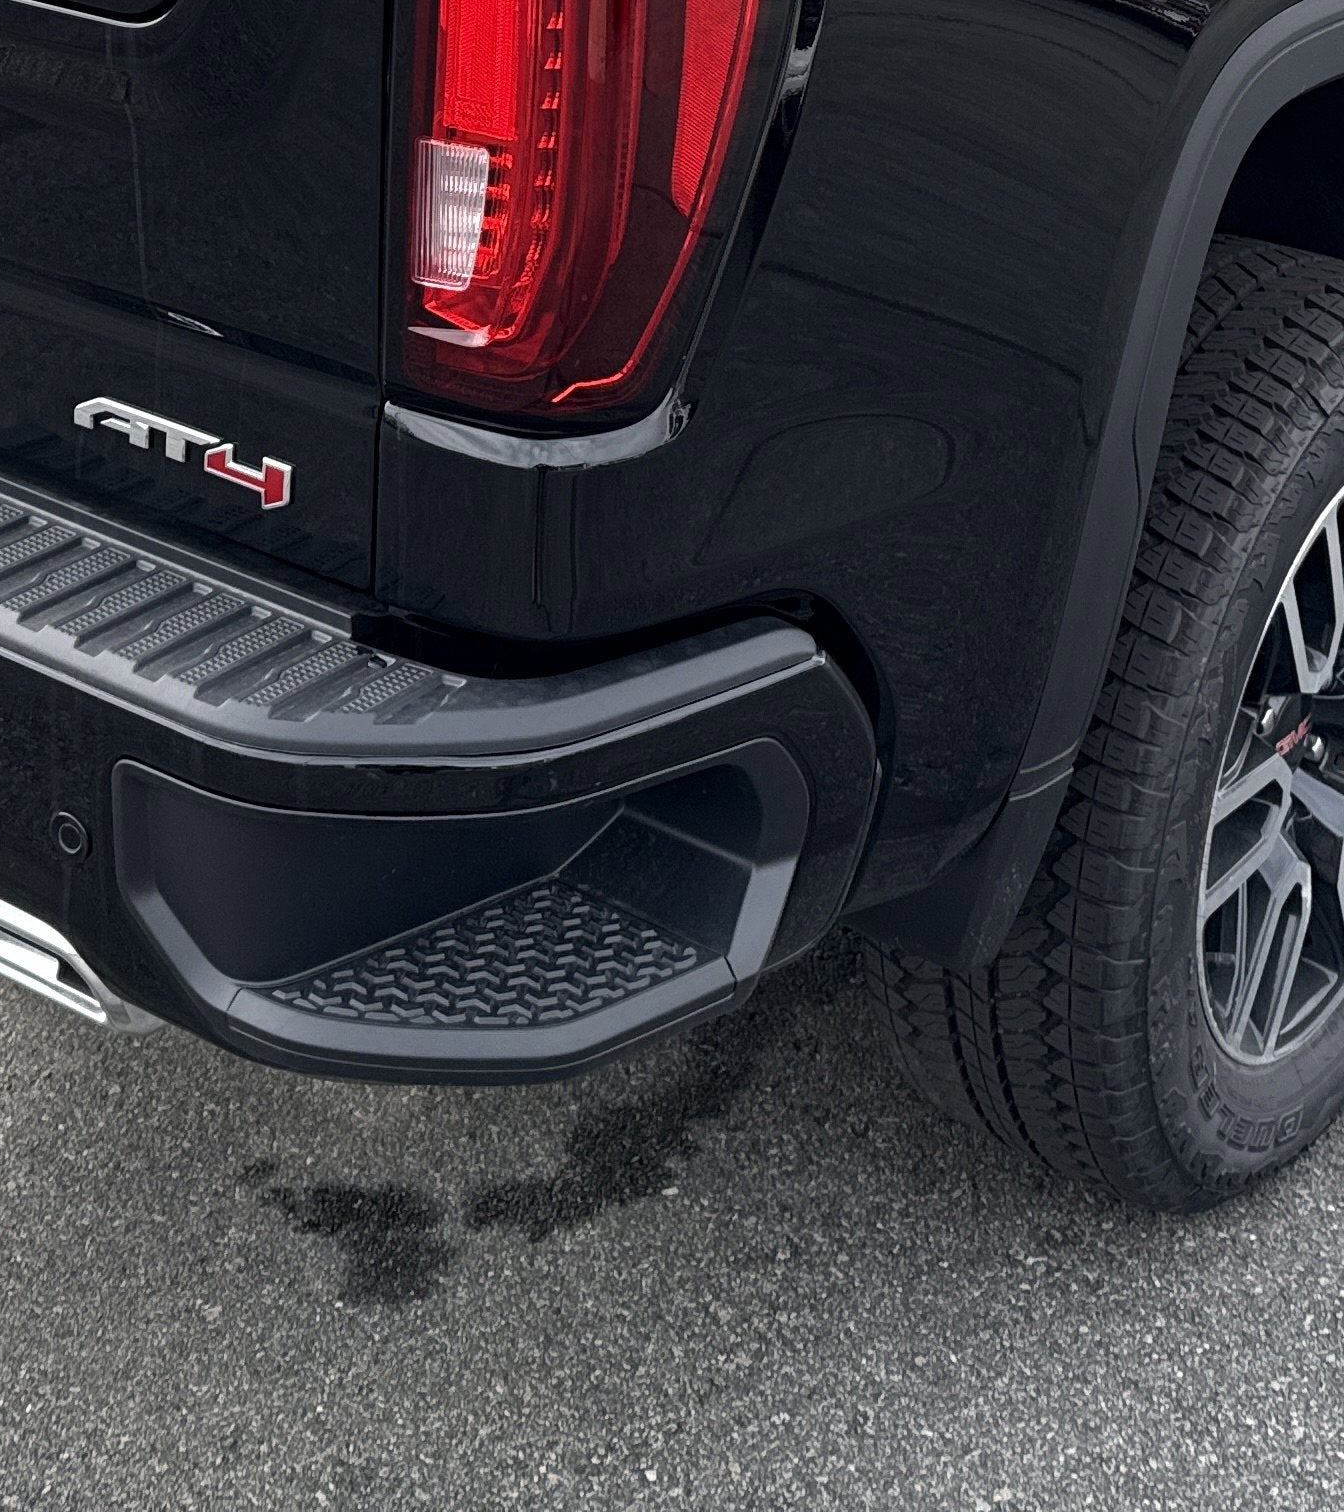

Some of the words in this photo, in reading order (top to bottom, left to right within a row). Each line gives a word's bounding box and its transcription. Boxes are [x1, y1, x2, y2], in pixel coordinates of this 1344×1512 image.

[74, 396, 294, 510] AT4
[1275, 712, 1313, 756] GMC
[1190, 1044, 1304, 1152] DUELER
